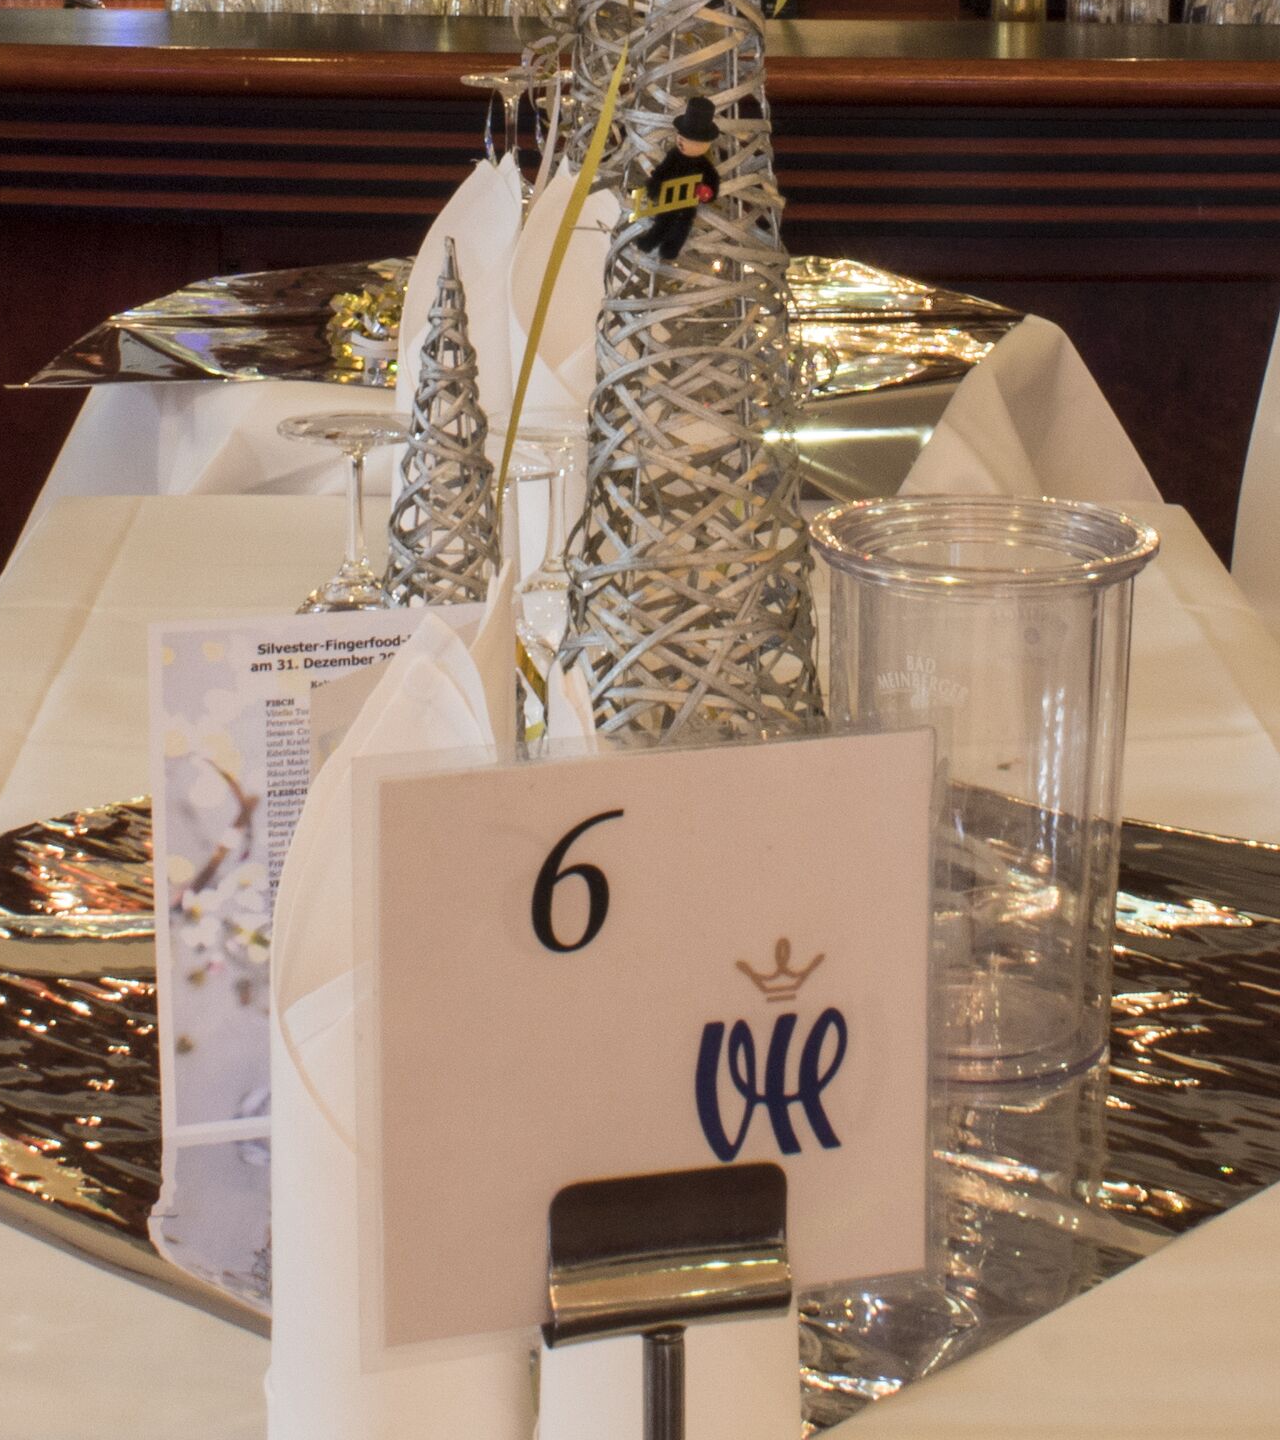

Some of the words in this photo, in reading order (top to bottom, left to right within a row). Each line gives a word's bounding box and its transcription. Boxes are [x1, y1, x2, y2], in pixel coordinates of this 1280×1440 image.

[257, 634, 412, 656] Silvester-Fingerfood-
[250, 661, 273, 673] am
[276, 659, 299, 672] 31.
[303, 654, 374, 670] Dezember
[906, 654, 937, 674] BAD
[877, 670, 969, 702] MEINBERGER
[266, 698, 295, 707] FISCH
[267, 788, 308, 797] FLEISCH
[531, 808, 625, 954] 6
